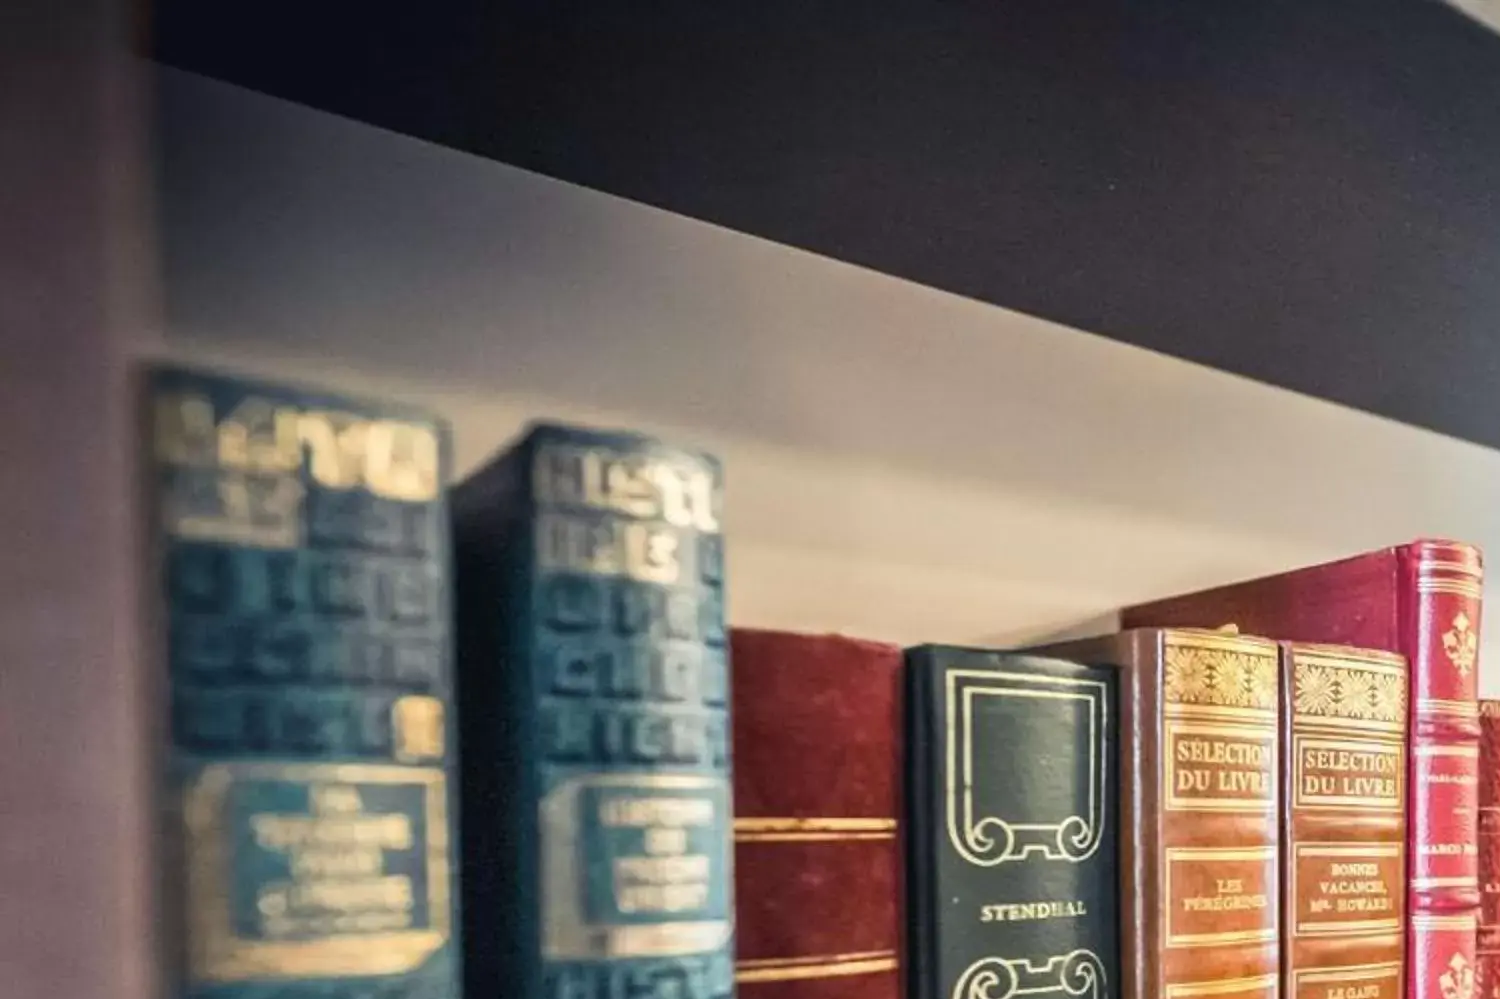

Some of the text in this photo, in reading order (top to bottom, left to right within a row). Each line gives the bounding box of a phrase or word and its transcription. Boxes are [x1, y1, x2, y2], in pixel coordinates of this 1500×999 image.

[1177, 769, 1271, 793] DU LIVRE
[1305, 775, 1335, 795] DU
[1343, 777, 1396, 797] LIVRE
[1216, 879, 1243, 893] LES
[980, 901, 1087, 922] STENDHAL
